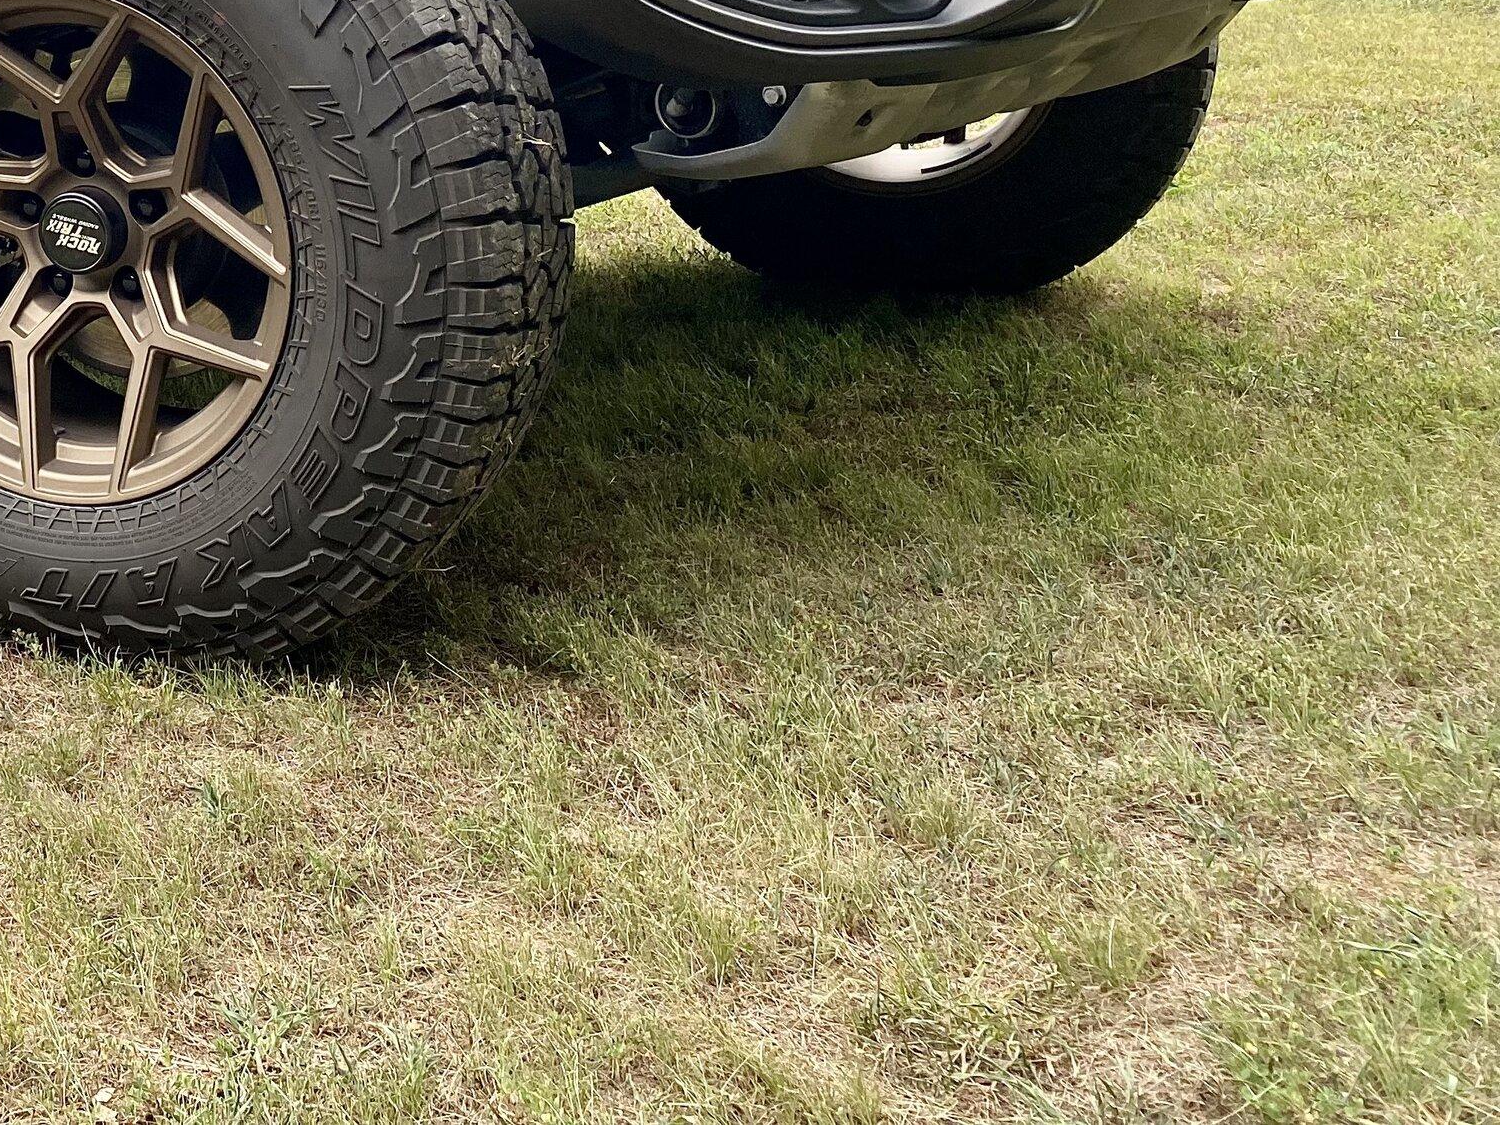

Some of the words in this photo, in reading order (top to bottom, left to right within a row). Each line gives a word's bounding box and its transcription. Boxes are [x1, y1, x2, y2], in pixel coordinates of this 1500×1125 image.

[55, 234, 101, 254] ROCK
[193, 84, 385, 593] WILDPEAK
[19, 556, 179, 611] A/T
